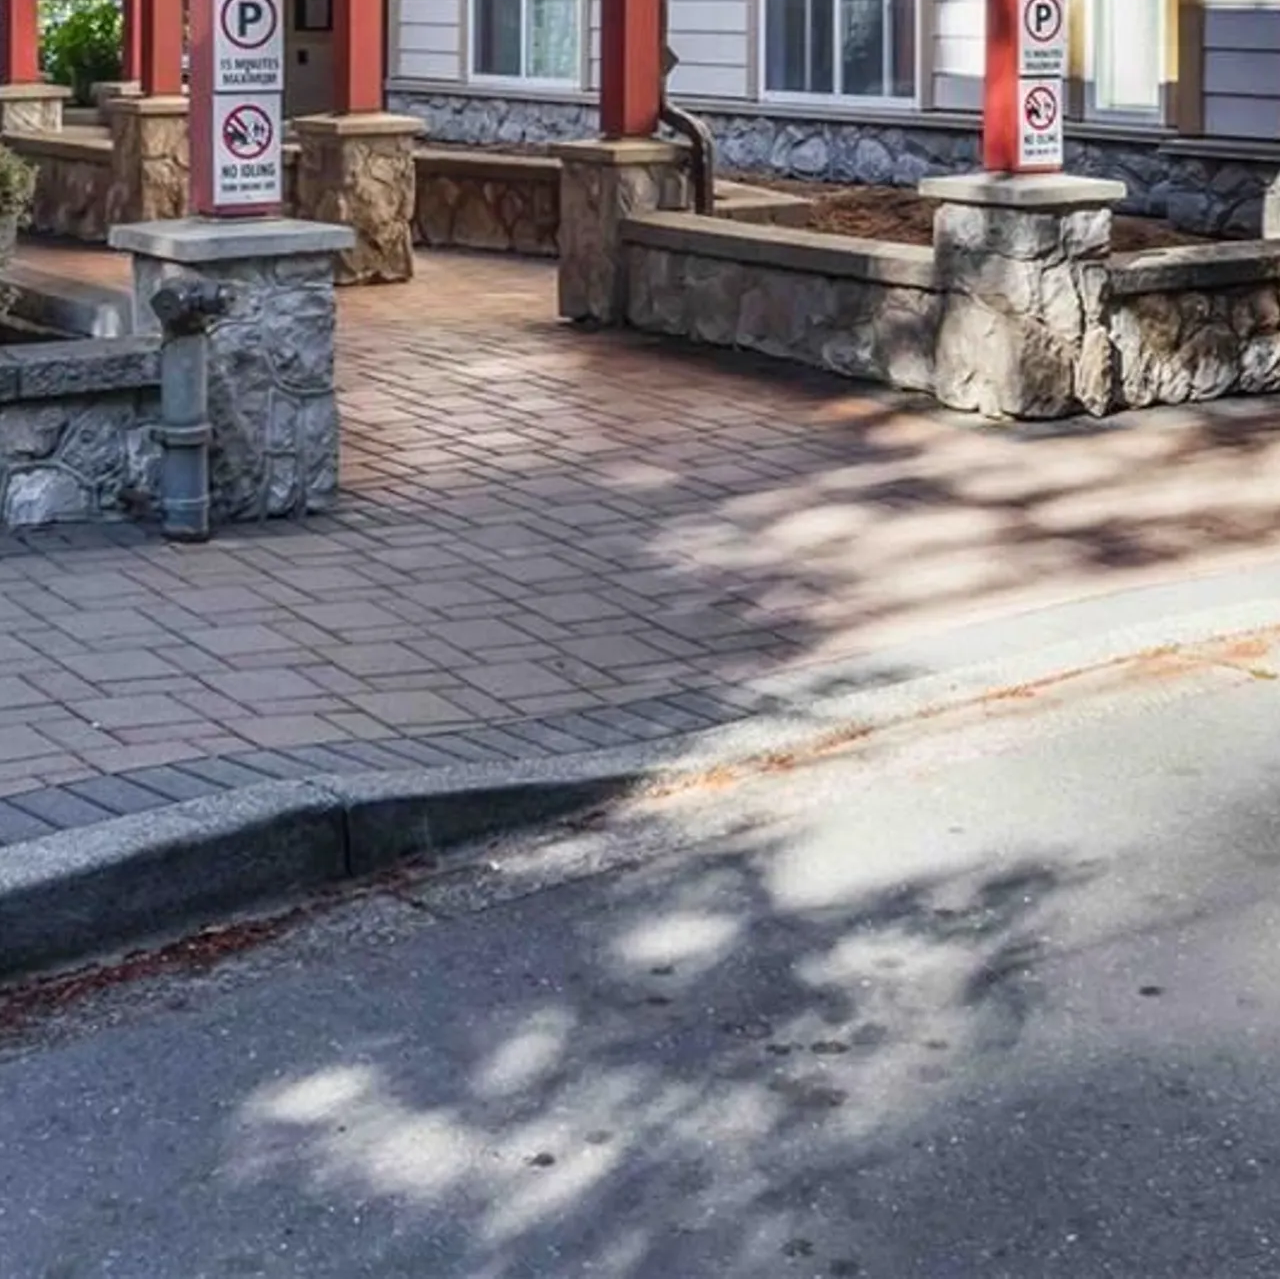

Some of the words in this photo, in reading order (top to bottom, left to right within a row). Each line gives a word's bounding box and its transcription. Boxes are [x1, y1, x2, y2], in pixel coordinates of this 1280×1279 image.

[238, 1, 262, 37] P
[1035, 3, 1052, 32] P
[222, 164, 237, 178] NO
[240, 162, 275, 178] IDLING
